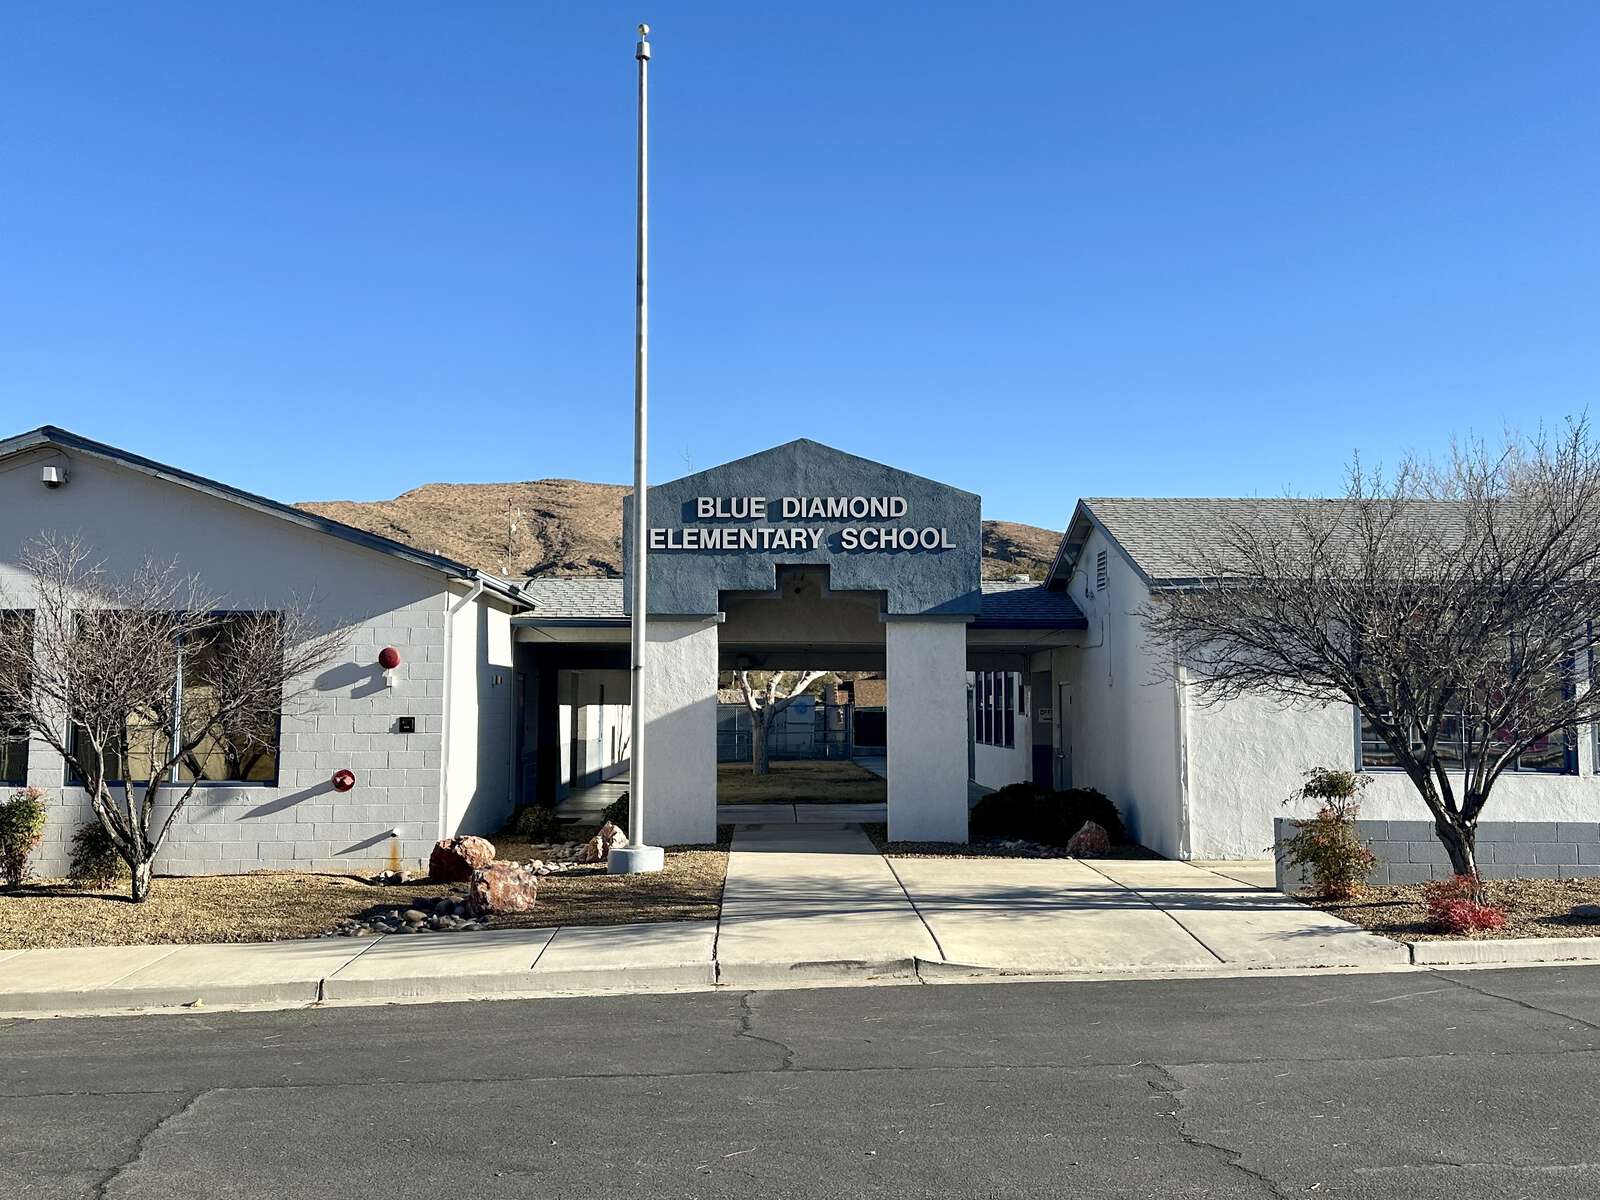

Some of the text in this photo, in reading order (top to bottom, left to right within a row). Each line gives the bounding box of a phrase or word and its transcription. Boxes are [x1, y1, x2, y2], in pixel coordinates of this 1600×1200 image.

[697, 496, 908, 518] BLUE DIAMOND
[650, 527, 957, 550] ELEMENTARY SCHOOL
